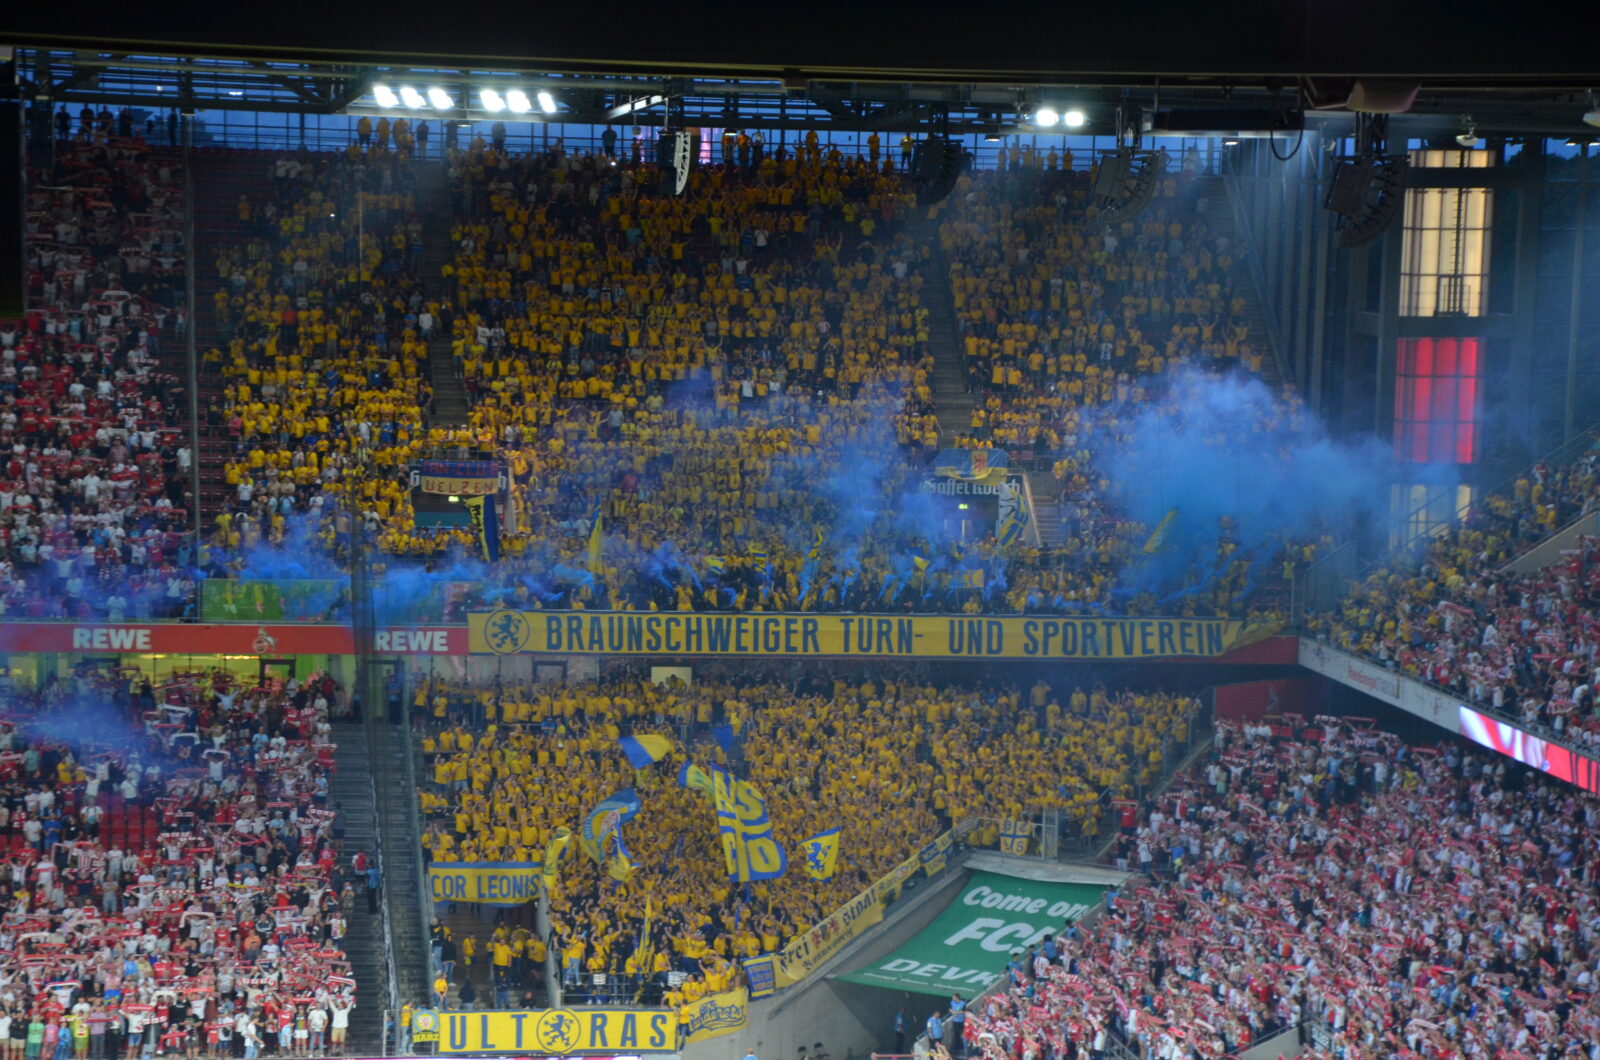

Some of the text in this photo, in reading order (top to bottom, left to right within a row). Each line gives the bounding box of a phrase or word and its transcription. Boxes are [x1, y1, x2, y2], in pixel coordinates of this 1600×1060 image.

[424, 479, 494, 494] UELZEN
[73, 628, 152, 650] REWE
[374, 630, 448, 653] REWE
[545, 614, 1224, 657] BRAUNSCHWEIGER TURN- UND SPORTVEREIN
[430, 873, 541, 899] COR LEONIS
[963, 886, 1048, 914] Come
